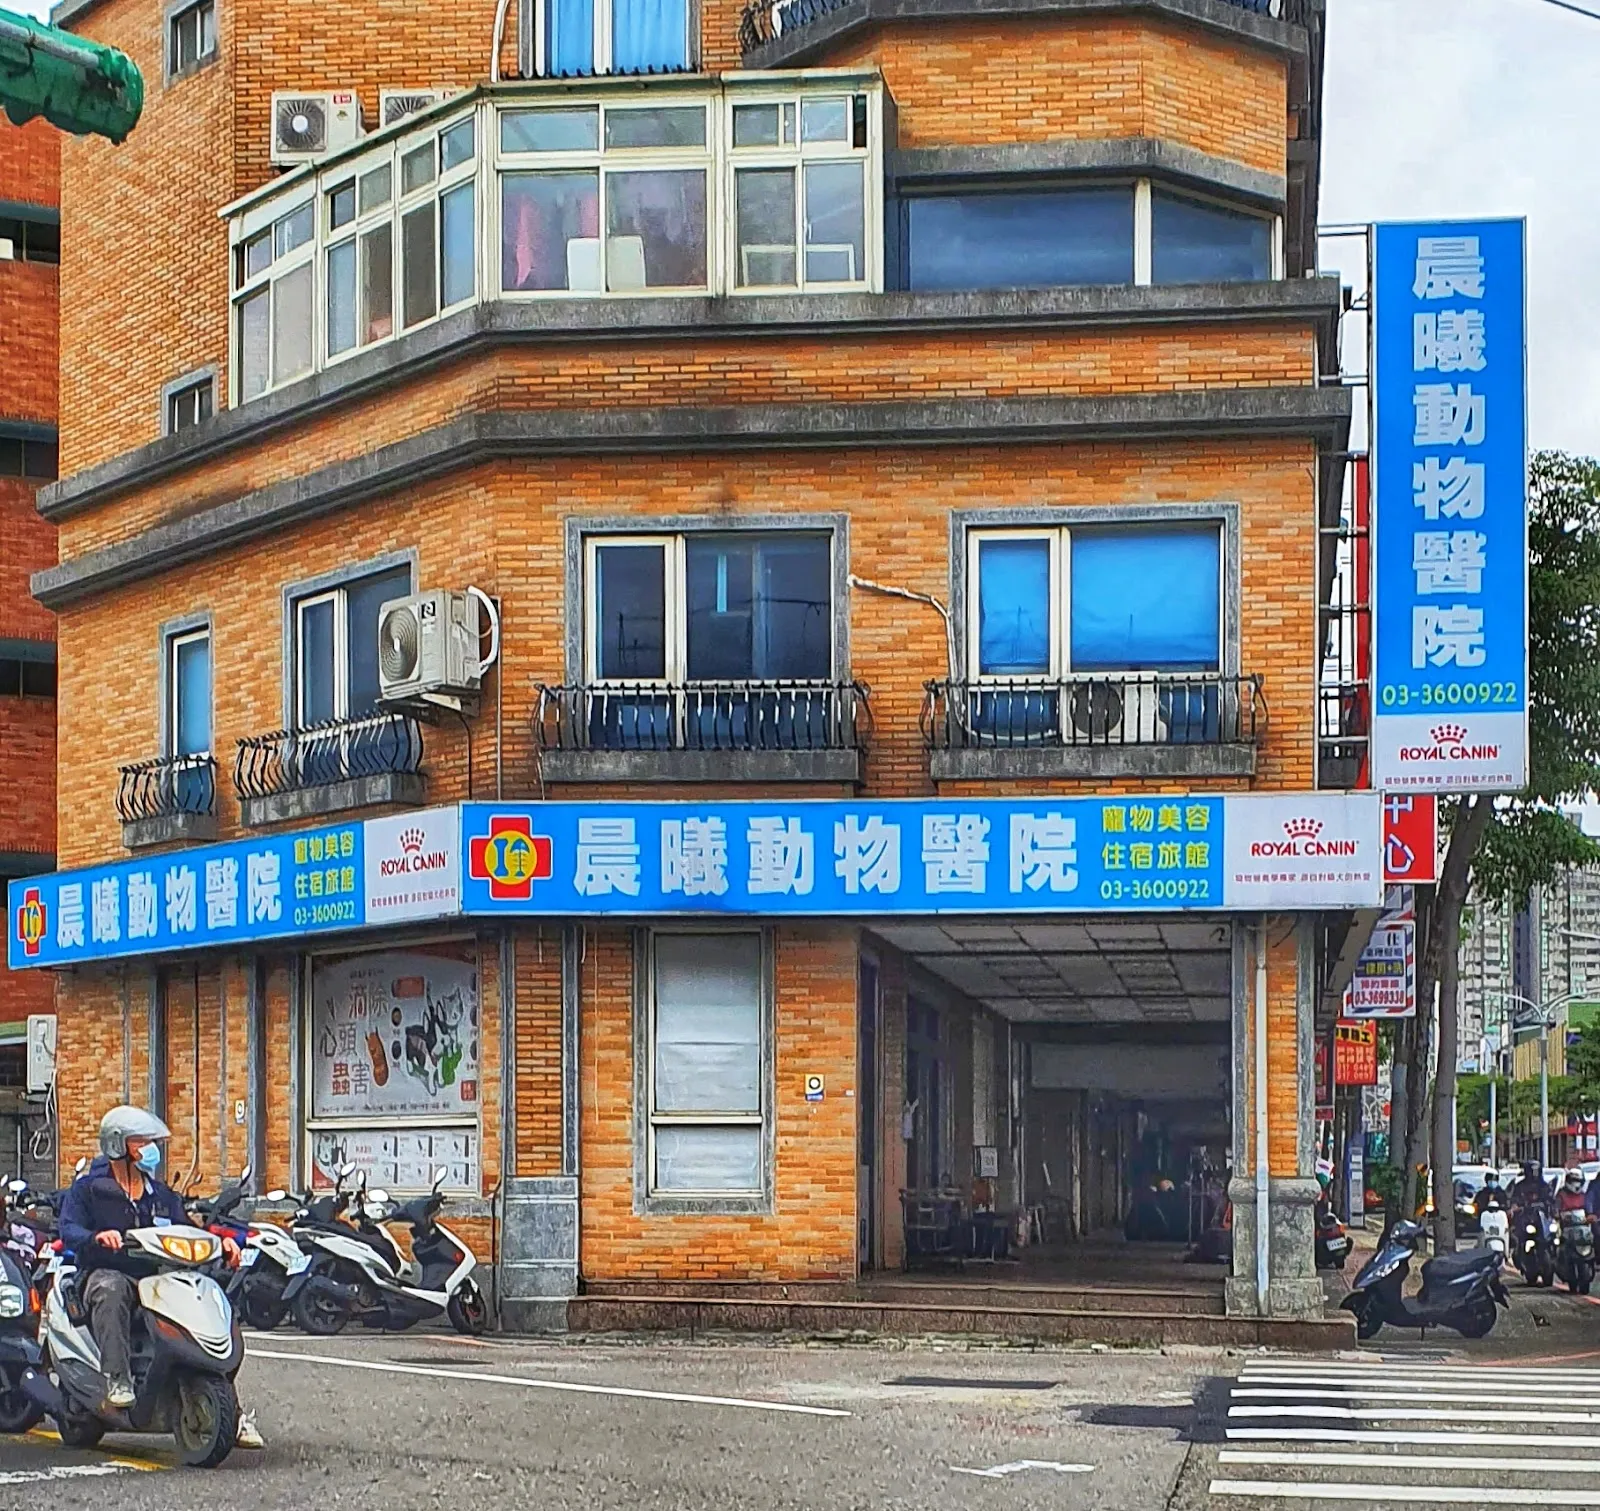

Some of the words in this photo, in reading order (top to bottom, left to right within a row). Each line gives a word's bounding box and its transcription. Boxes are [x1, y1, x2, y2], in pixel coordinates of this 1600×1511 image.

[1412, 236, 1487, 669] 晨曦動物醫院
[1382, 682, 1518, 706] 03-3600922
[1400, 745, 1446, 761] ROYAL
[1449, 743, 1498, 760] CANIN
[1102, 804, 1211, 833] 寵物美容
[294, 831, 355, 866] 寵物美容
[573, 812, 1079, 898] 晨曦動物醫院
[1102, 841, 1211, 870] 住宿旅館
[1251, 840, 1301, 857] ROYAL
[1304, 839, 1356, 856] CANIN
[381, 856, 411, 877] ROYAL
[413, 851, 447, 871] CANIN
[295, 865, 355, 899] 住宿旅館
[1100, 879, 1210, 900] 03-3600922
[57, 851, 282, 950] 晨曦動物醫院
[294, 900, 356, 926] 03-3600922
